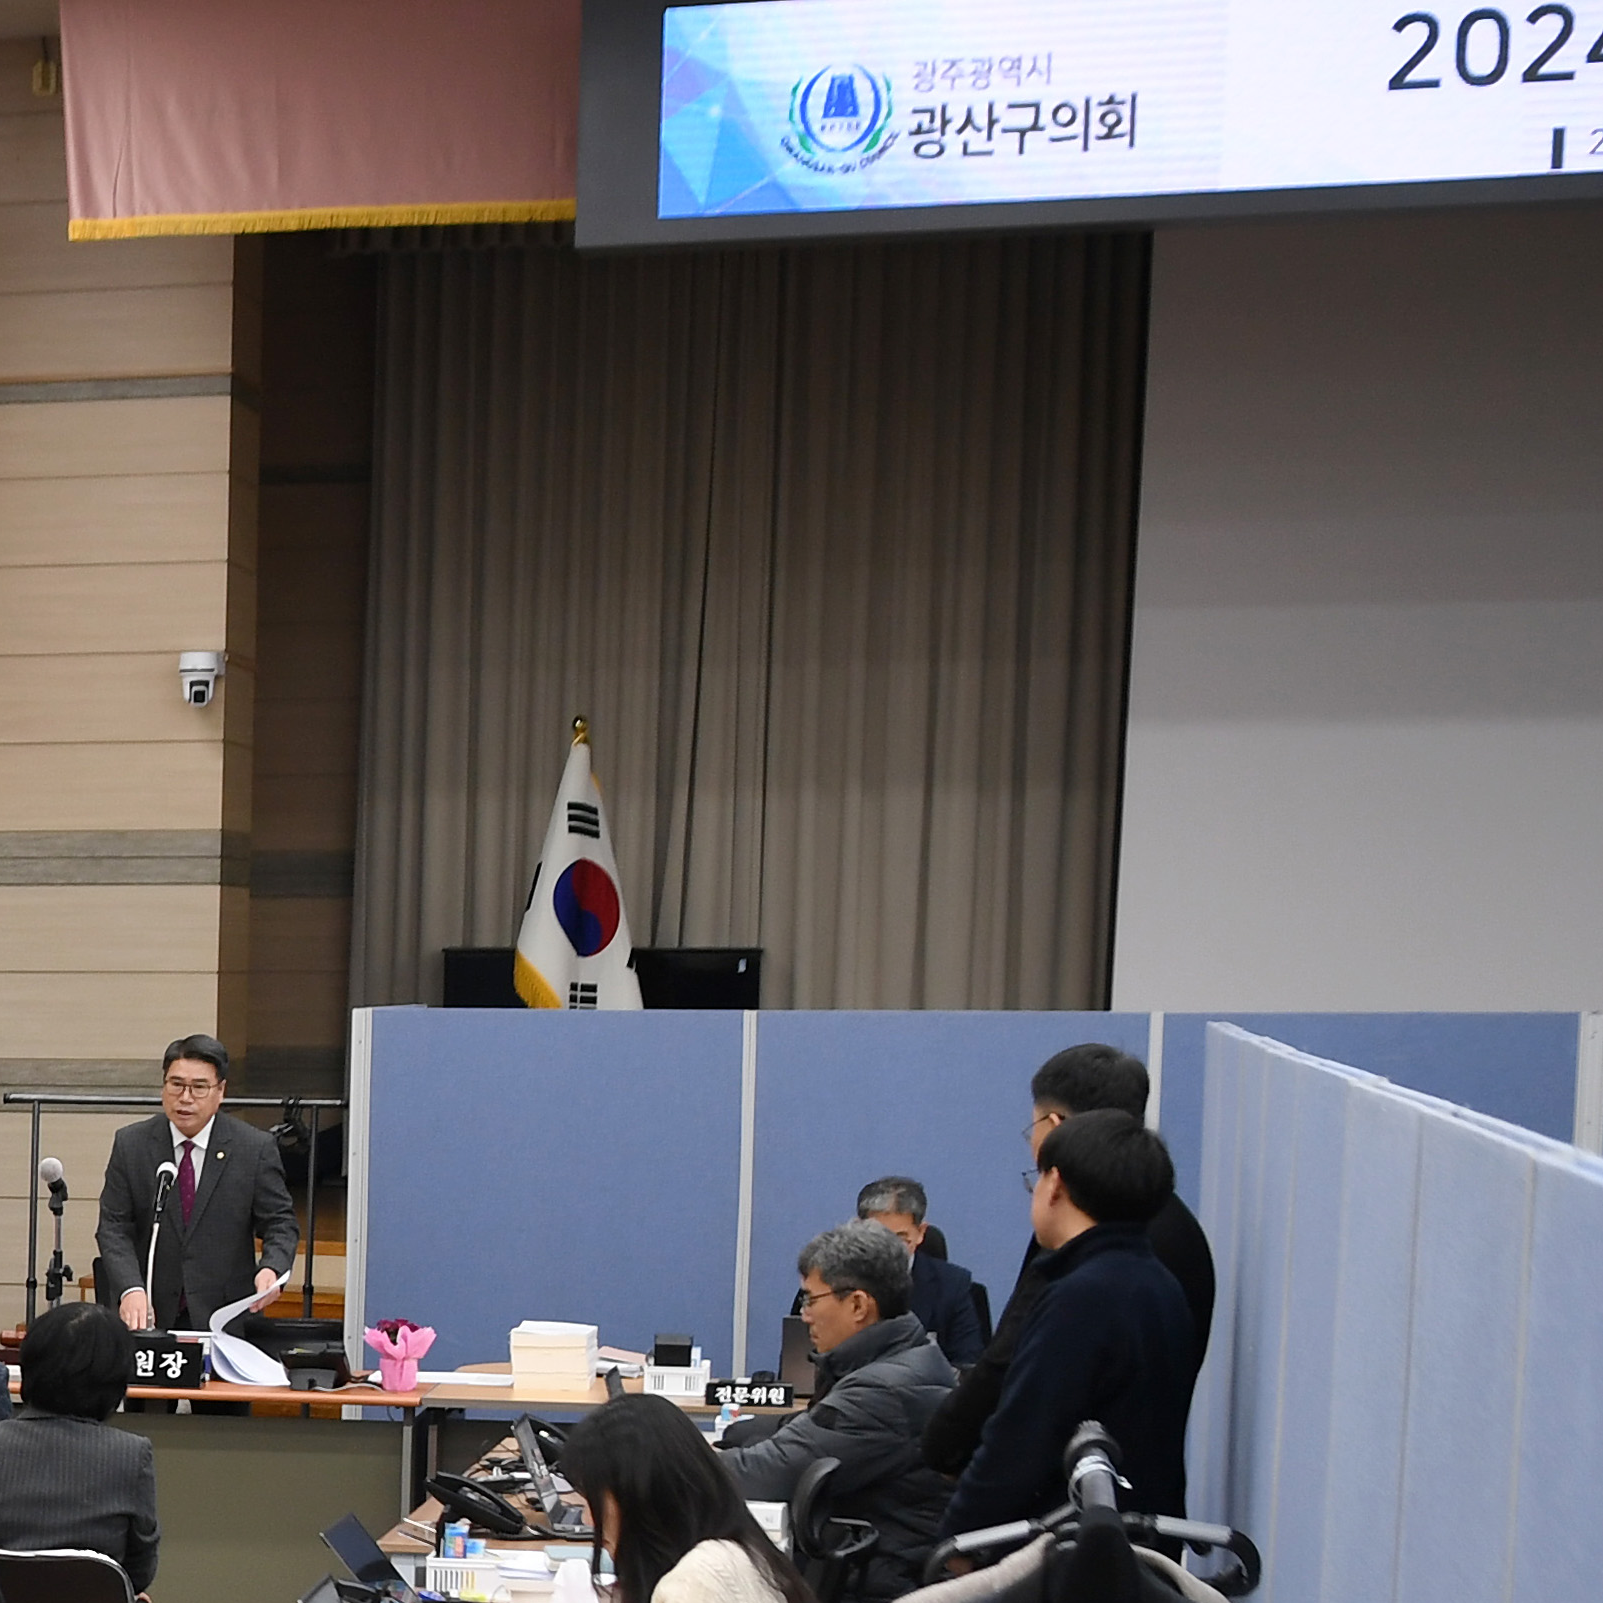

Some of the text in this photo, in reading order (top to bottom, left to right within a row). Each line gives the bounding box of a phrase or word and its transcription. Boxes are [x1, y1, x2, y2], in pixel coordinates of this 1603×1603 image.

[912, 52, 1053, 93] 광주광역시
[907, 92, 1138, 159] 광산구의회
[714, 1385, 786, 1405] 전문위원
